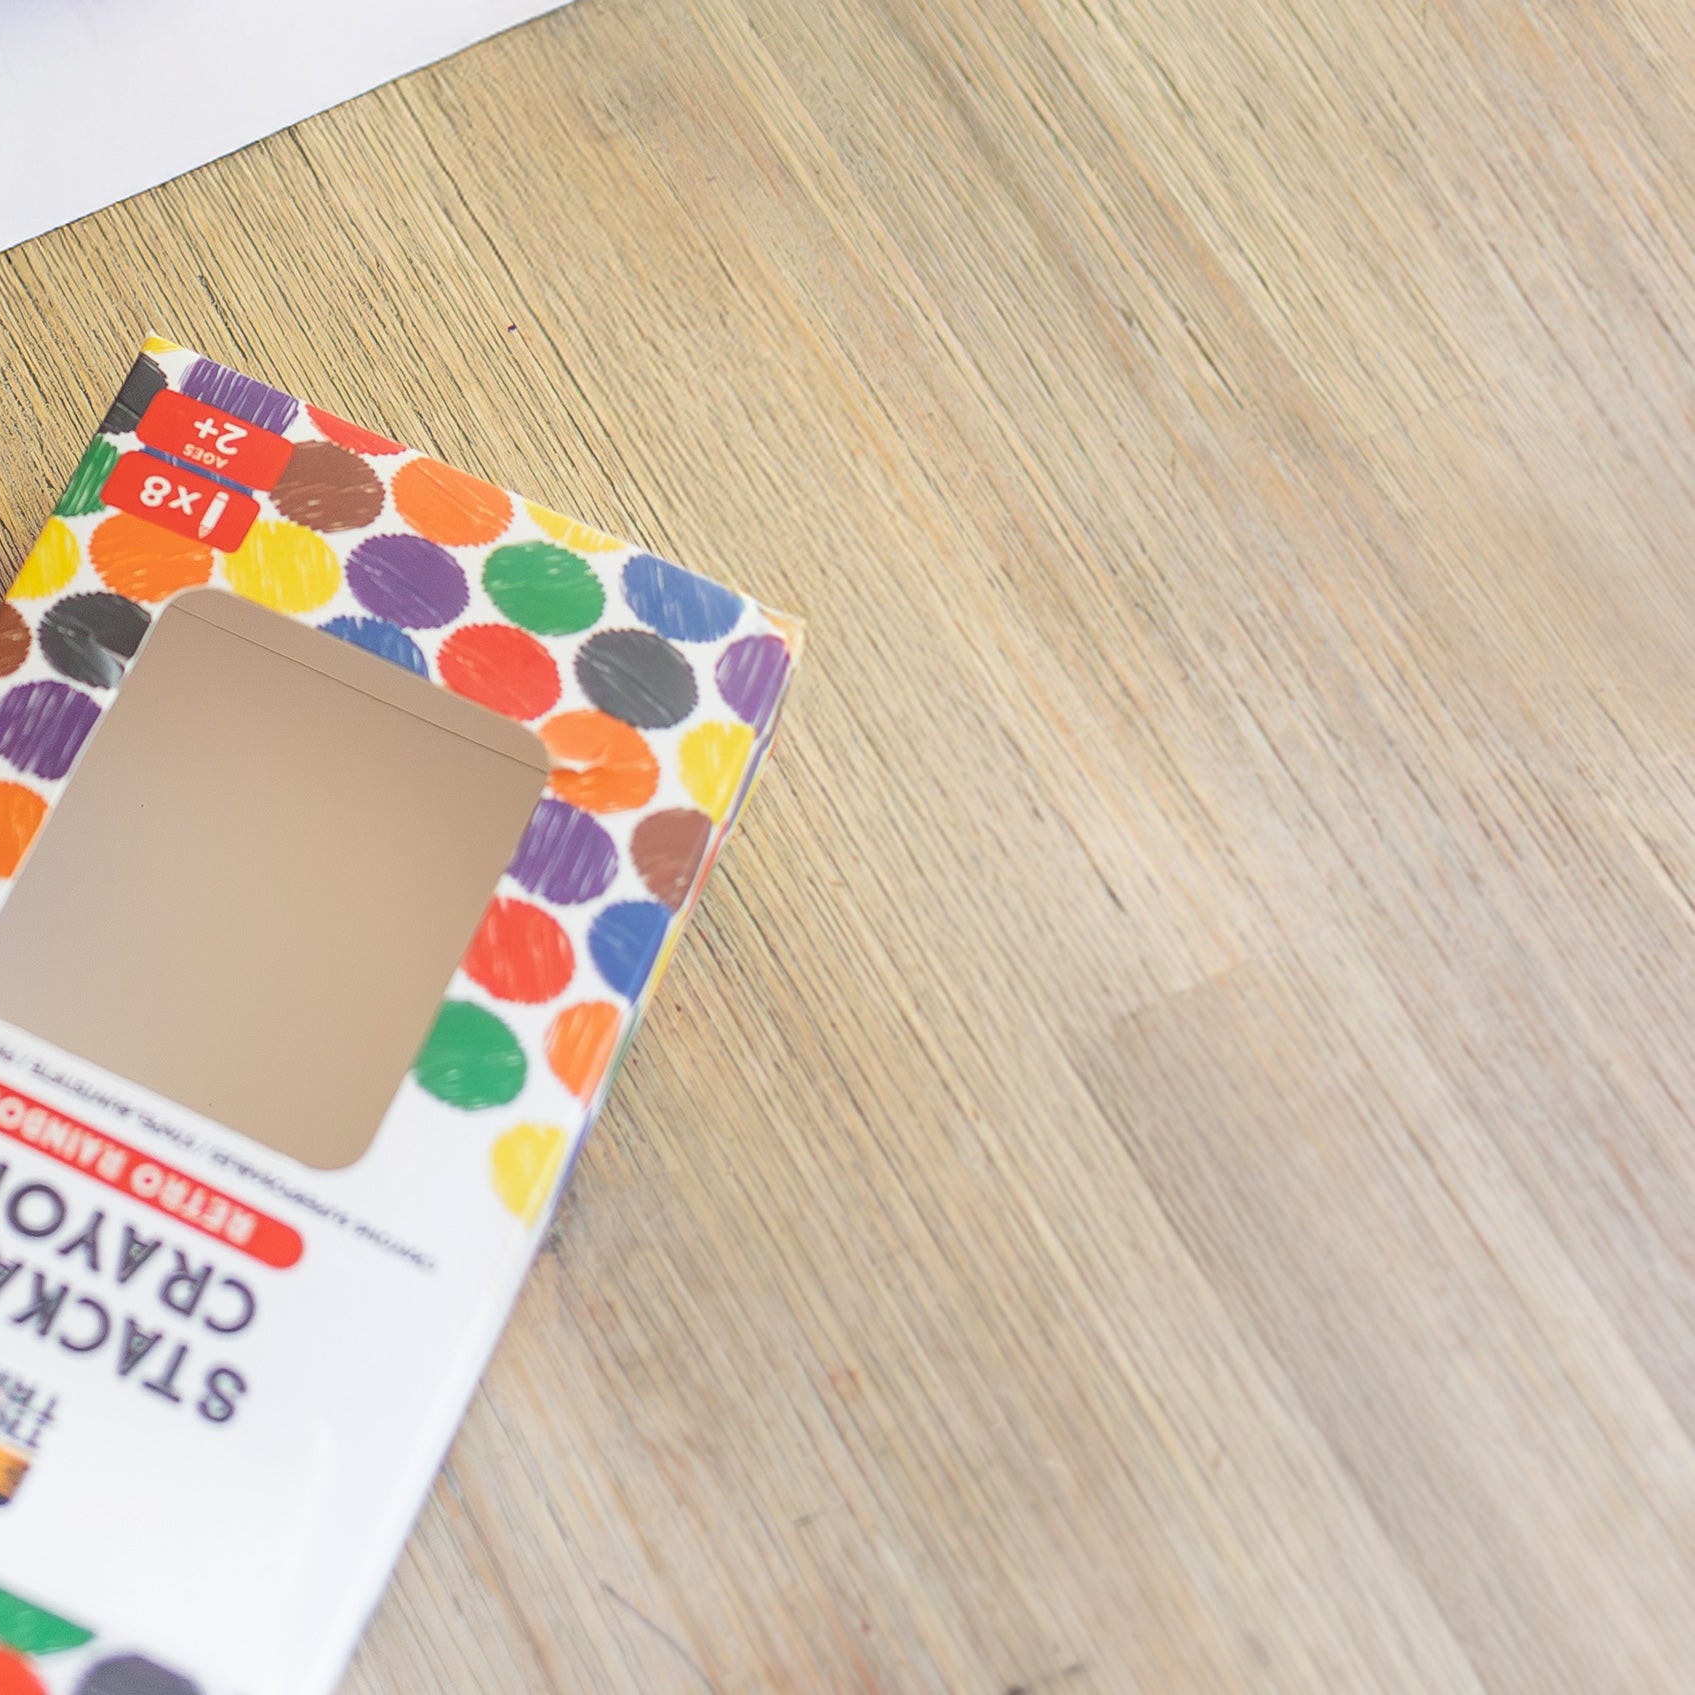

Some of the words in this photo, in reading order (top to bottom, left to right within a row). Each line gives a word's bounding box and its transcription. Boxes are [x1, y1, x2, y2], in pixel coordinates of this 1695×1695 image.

[194, 418, 248, 454] 2+
[183, 443, 229, 469] AGES
[130, 1163, 257, 1246] RETRO
